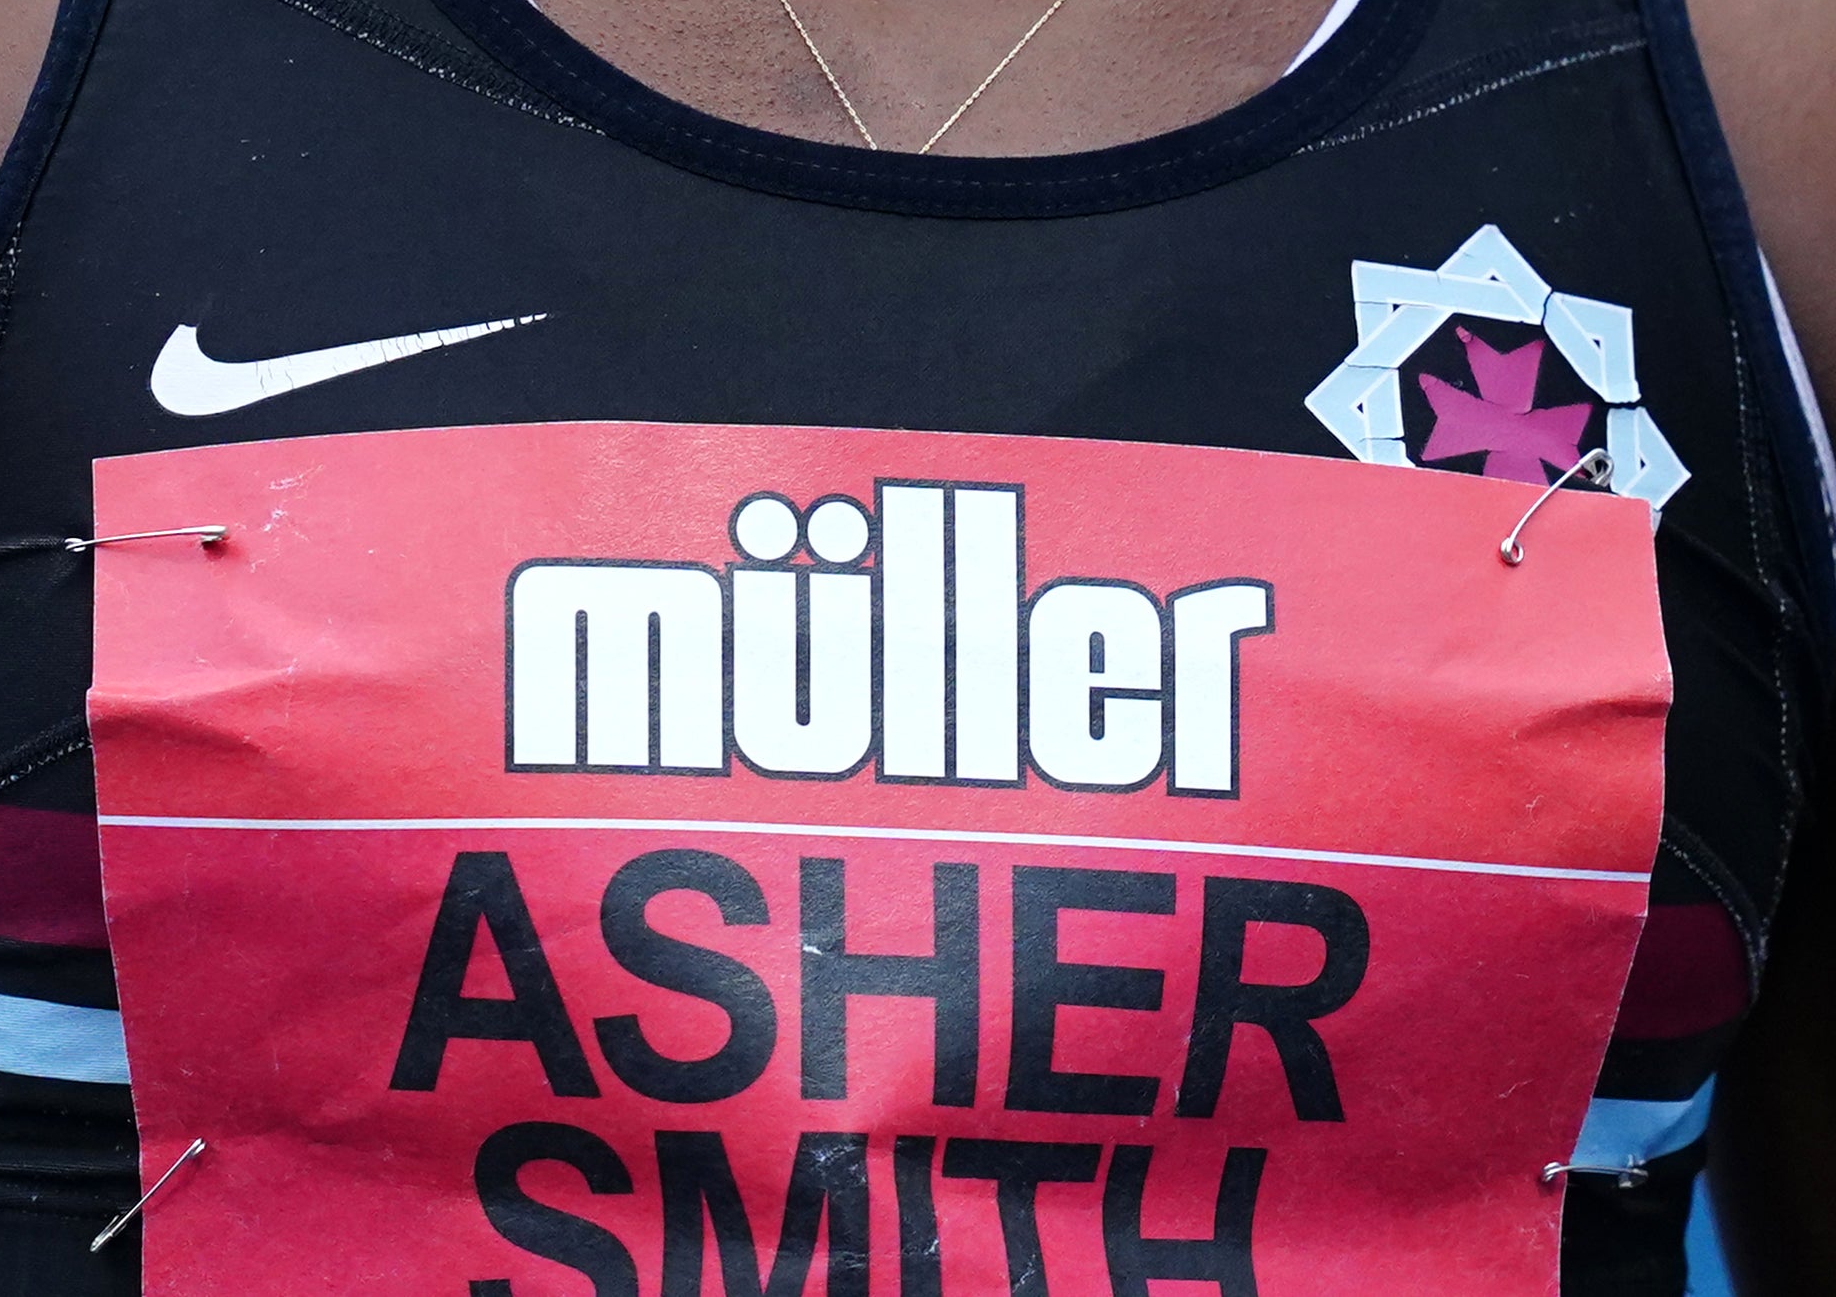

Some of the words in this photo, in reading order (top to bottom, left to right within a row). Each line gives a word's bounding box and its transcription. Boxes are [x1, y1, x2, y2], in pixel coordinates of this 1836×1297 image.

[505, 479, 1275, 798] müller
[391, 850, 1370, 1124] ASHER
[469, 1124, 1268, 1297] SMITH
